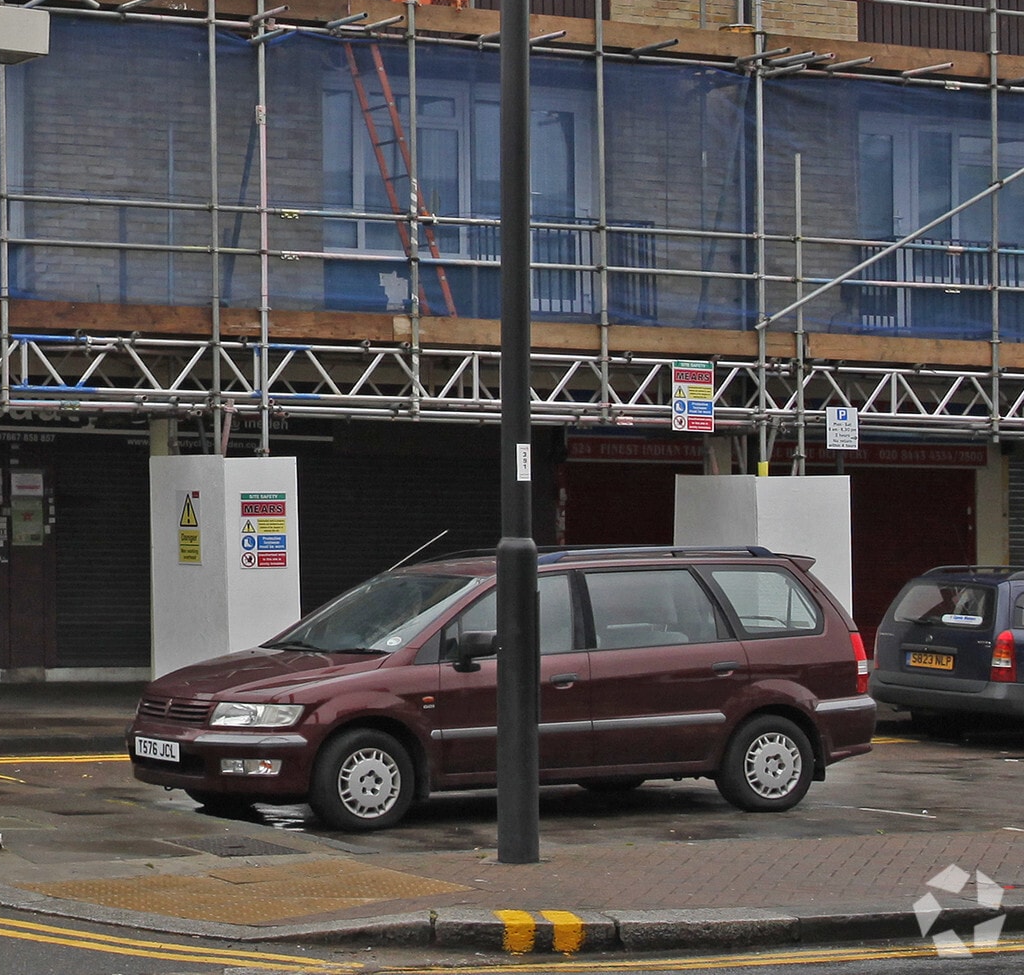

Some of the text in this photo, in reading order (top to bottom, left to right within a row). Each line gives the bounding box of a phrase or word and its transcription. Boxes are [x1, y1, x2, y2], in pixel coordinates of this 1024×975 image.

[677, 372, 710, 381] MEARS
[600, 443, 639, 456] FINEST
[244, 505, 283, 514] MEARS
[912, 653, 952, 667] S823 NLP
[139, 740, 176, 759] T576 JCL
